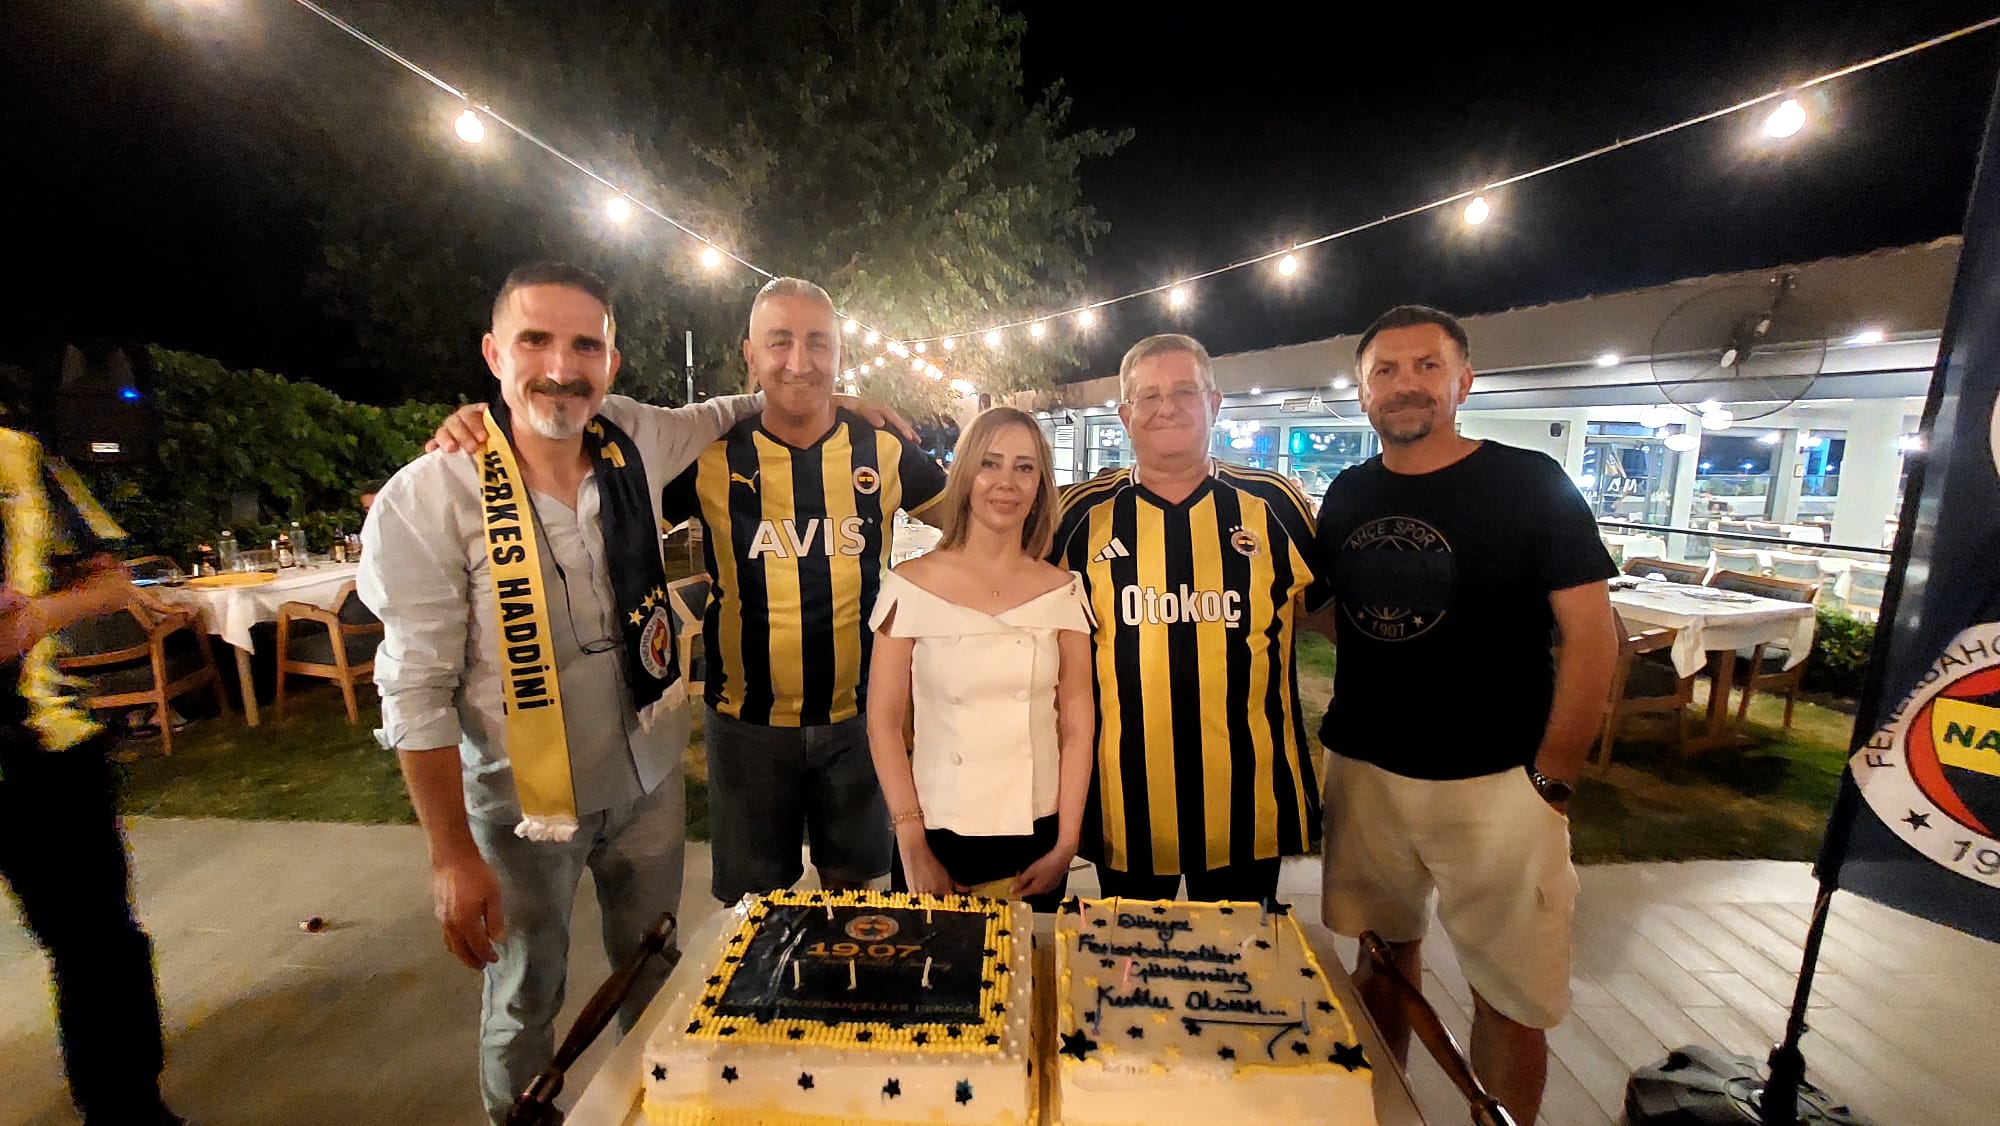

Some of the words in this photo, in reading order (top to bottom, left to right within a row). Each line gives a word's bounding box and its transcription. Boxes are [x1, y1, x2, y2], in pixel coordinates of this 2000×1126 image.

[748, 516, 866, 559] AVIS
[1393, 520, 1437, 548] SPOR
[1121, 584, 1241, 628] Otokoç
[498, 576, 556, 711] HADDİNİ
[1372, 620, 1405, 638] 1907
[1097, 985, 1174, 1011] Kutlu
